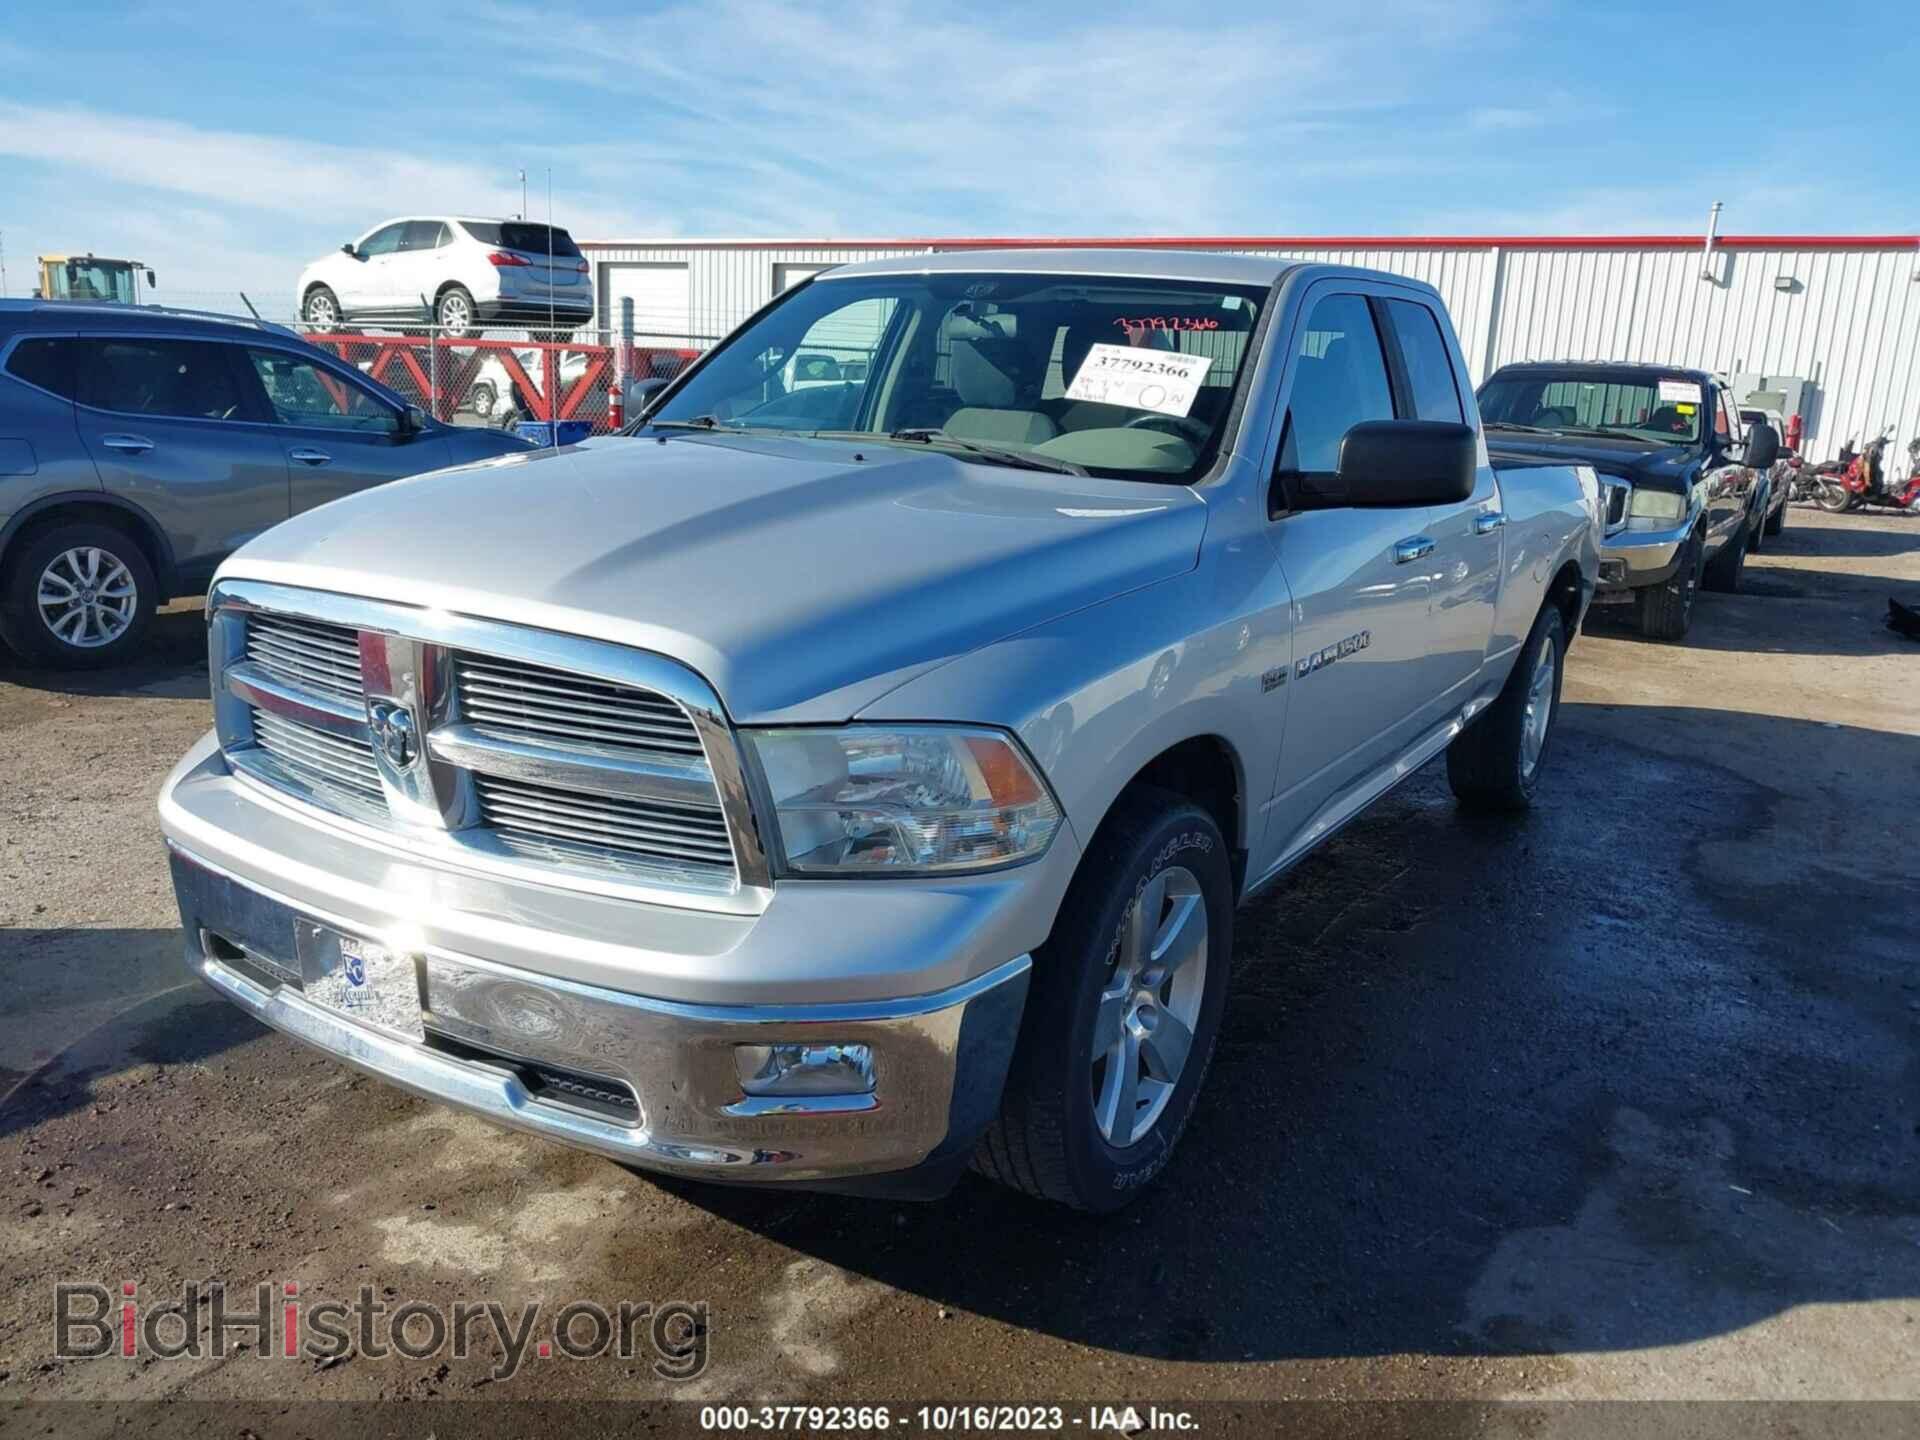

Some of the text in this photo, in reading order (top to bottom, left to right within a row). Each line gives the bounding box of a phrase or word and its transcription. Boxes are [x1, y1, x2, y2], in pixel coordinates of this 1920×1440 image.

[1113, 317, 1218, 335] 37792366
[1094, 355, 1190, 380] 37792366
[1295, 643, 1338, 680] RAM
